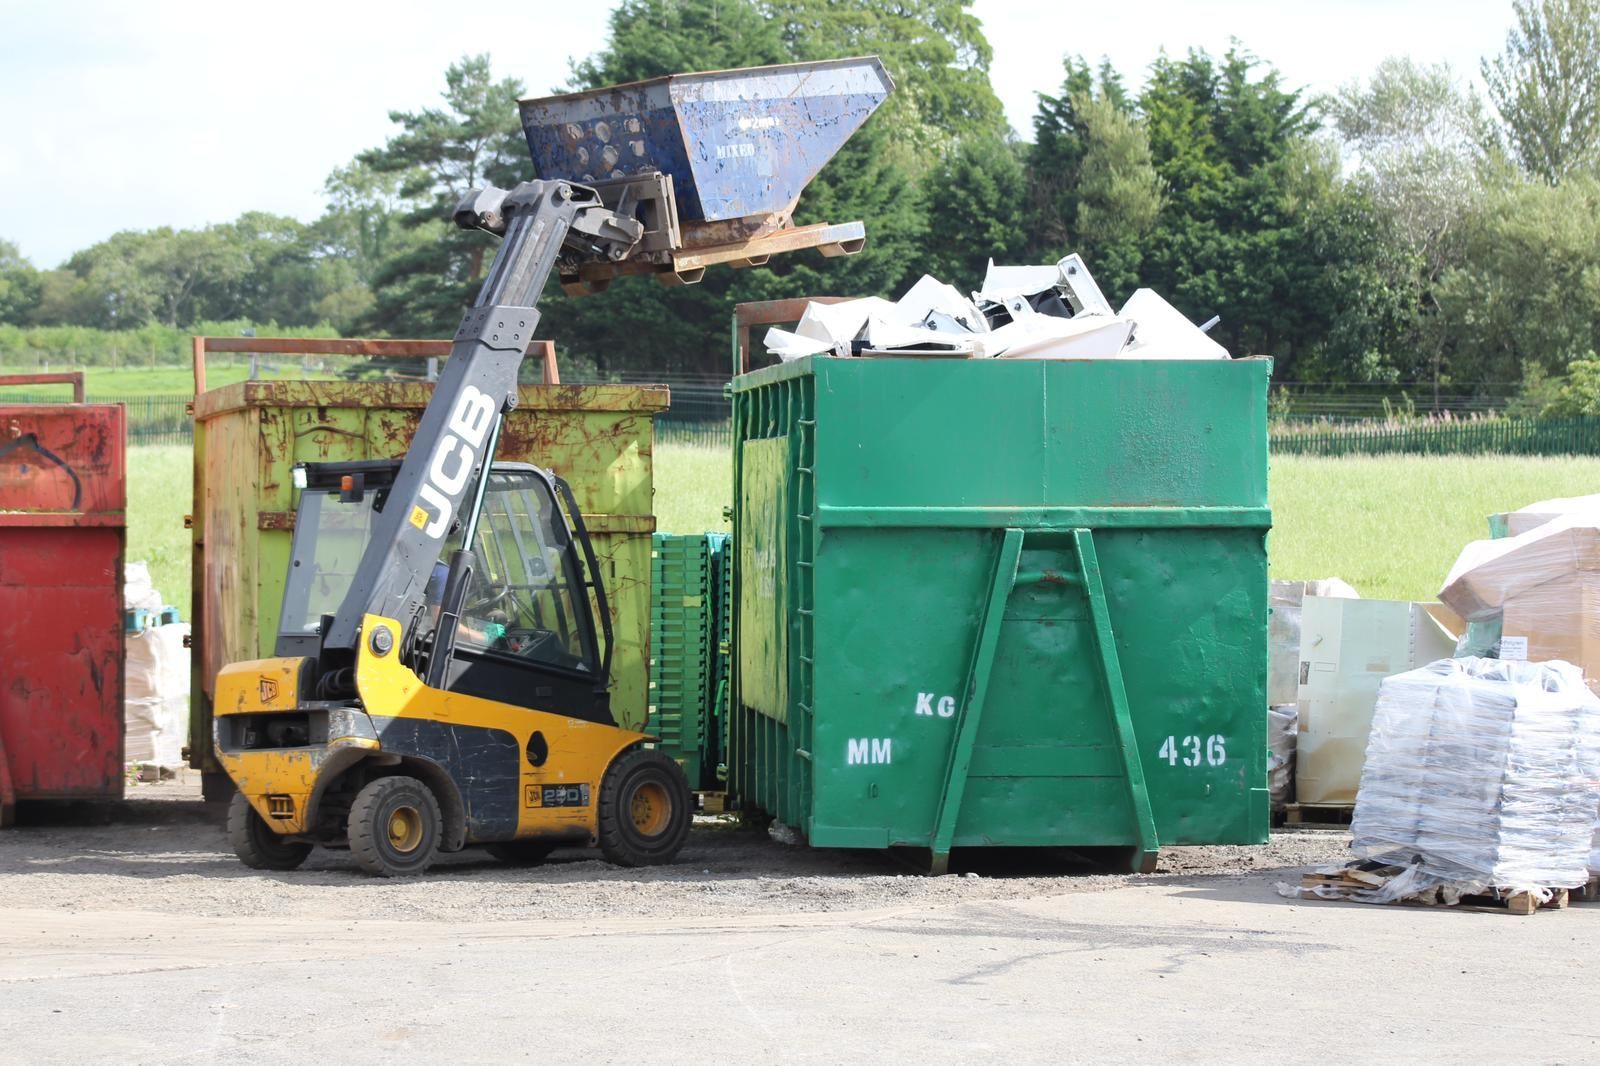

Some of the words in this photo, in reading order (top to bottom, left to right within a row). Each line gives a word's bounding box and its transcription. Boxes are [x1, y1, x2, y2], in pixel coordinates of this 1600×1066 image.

[419, 385, 495, 539] JCB
[915, 692, 956, 718] KG
[847, 738, 892, 765] MM
[1158, 734, 1226, 767] 436
